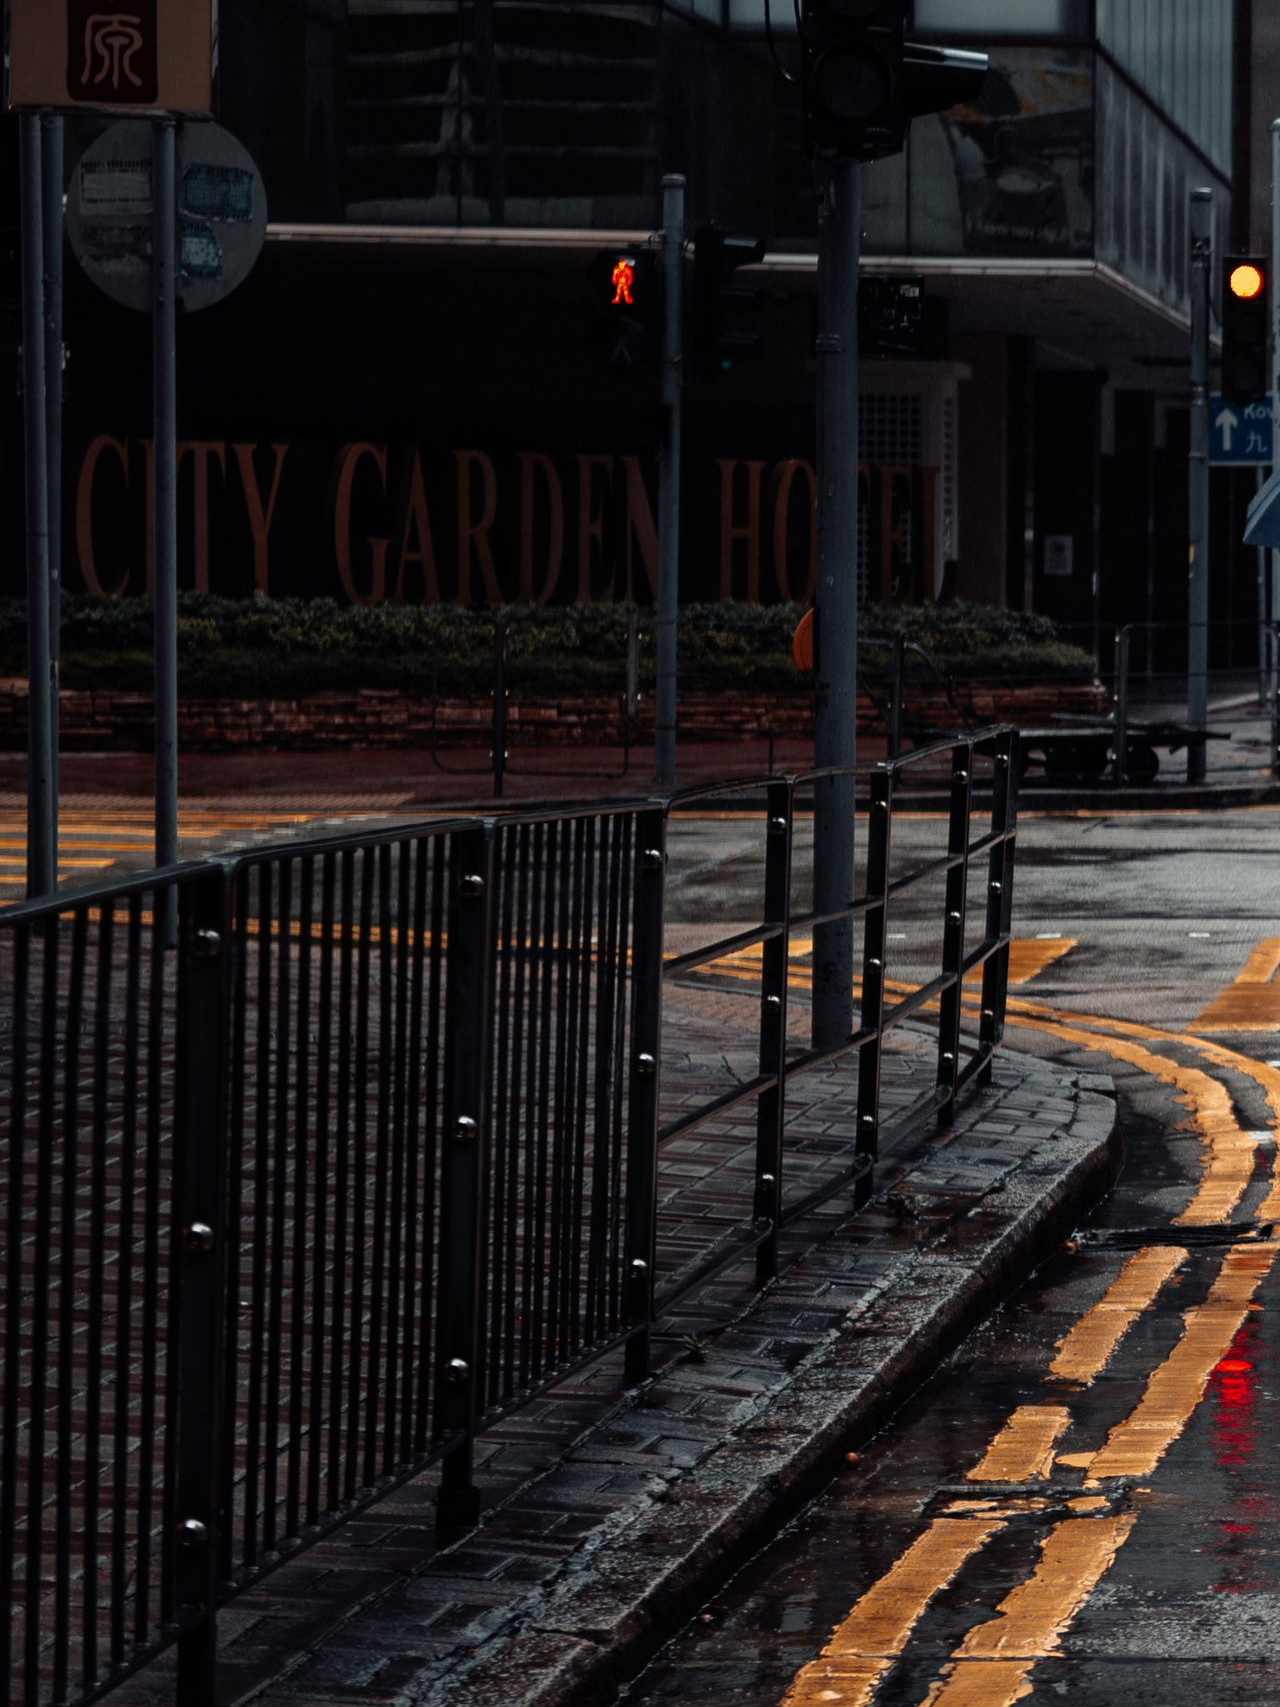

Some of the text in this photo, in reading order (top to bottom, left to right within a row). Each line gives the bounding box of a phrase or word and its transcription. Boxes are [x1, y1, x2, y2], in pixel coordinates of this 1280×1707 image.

[75, 434, 956, 605] CITY GARDEN HOEL
